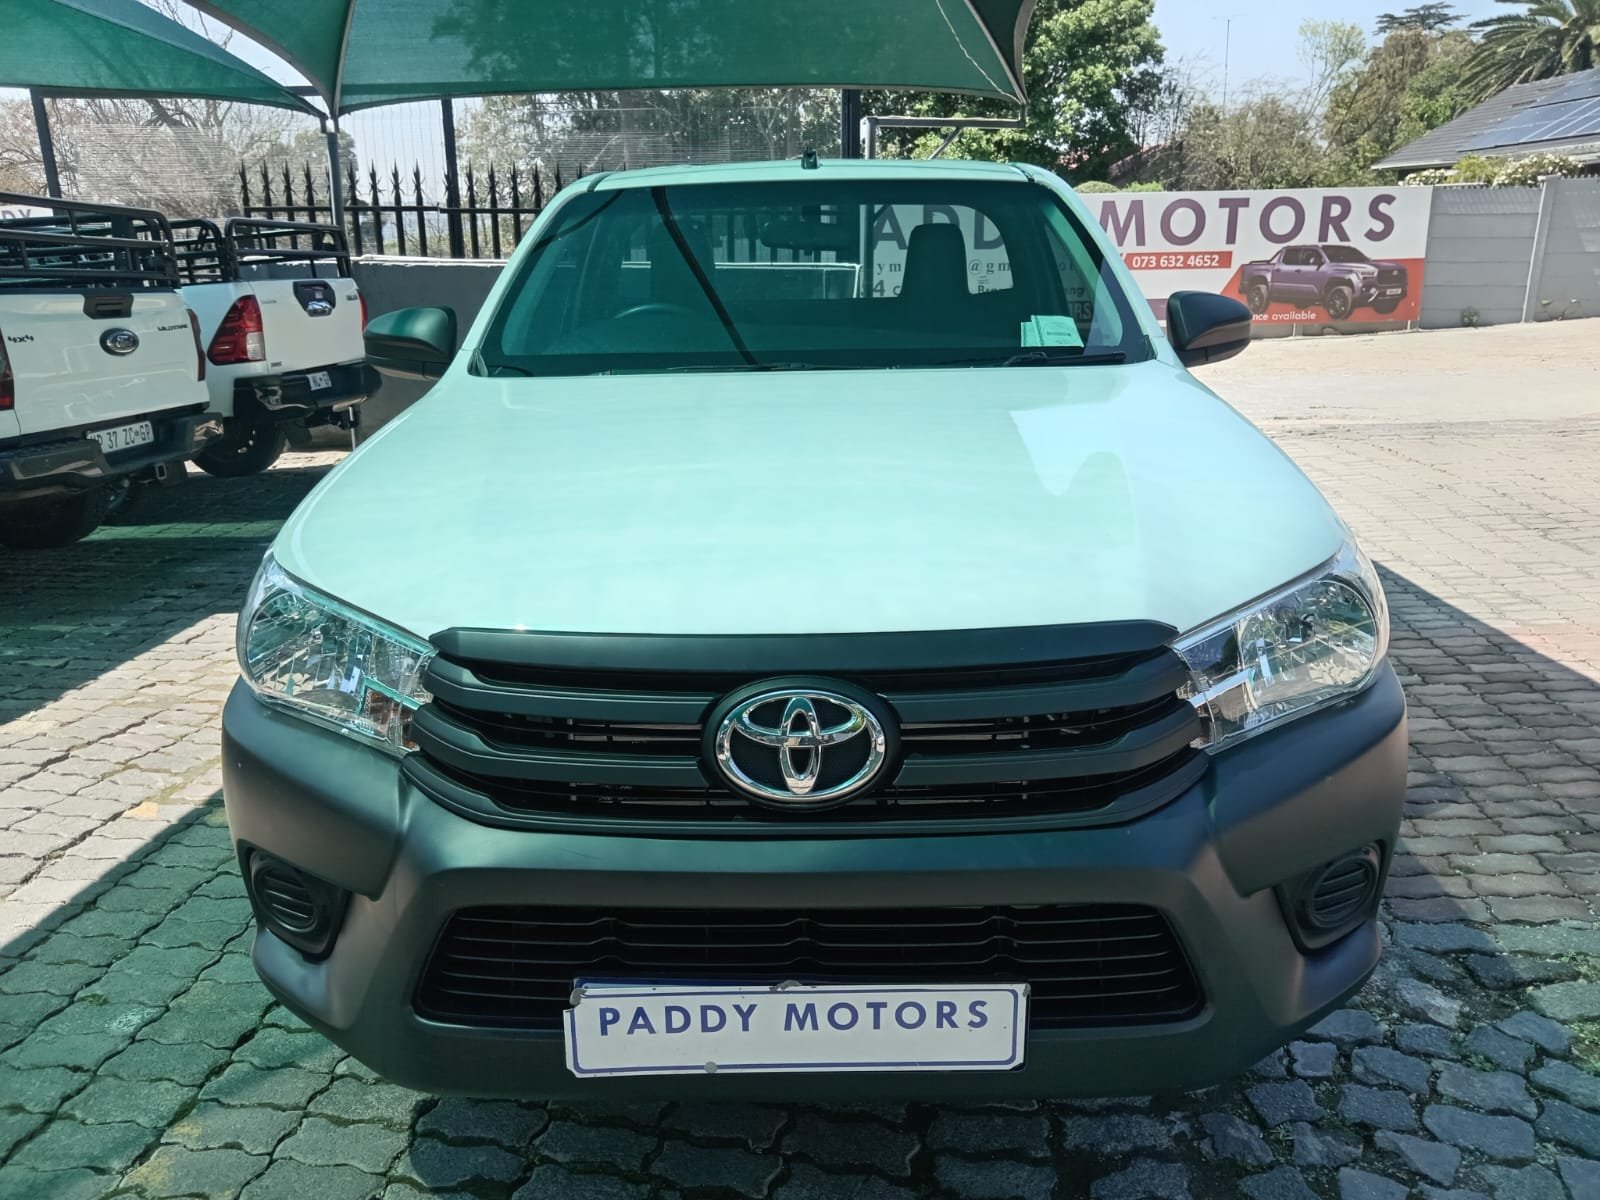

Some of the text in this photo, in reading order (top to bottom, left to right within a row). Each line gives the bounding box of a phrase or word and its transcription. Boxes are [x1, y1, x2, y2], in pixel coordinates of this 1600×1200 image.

[1100, 194, 1397, 247] MOTORS
[1132, 254, 1220, 268] 073 632 4652
[1271, 310, 1317, 321] available
[106, 431, 118, 449] 37
[600, 1000, 989, 1036] PADDY MOTORS
